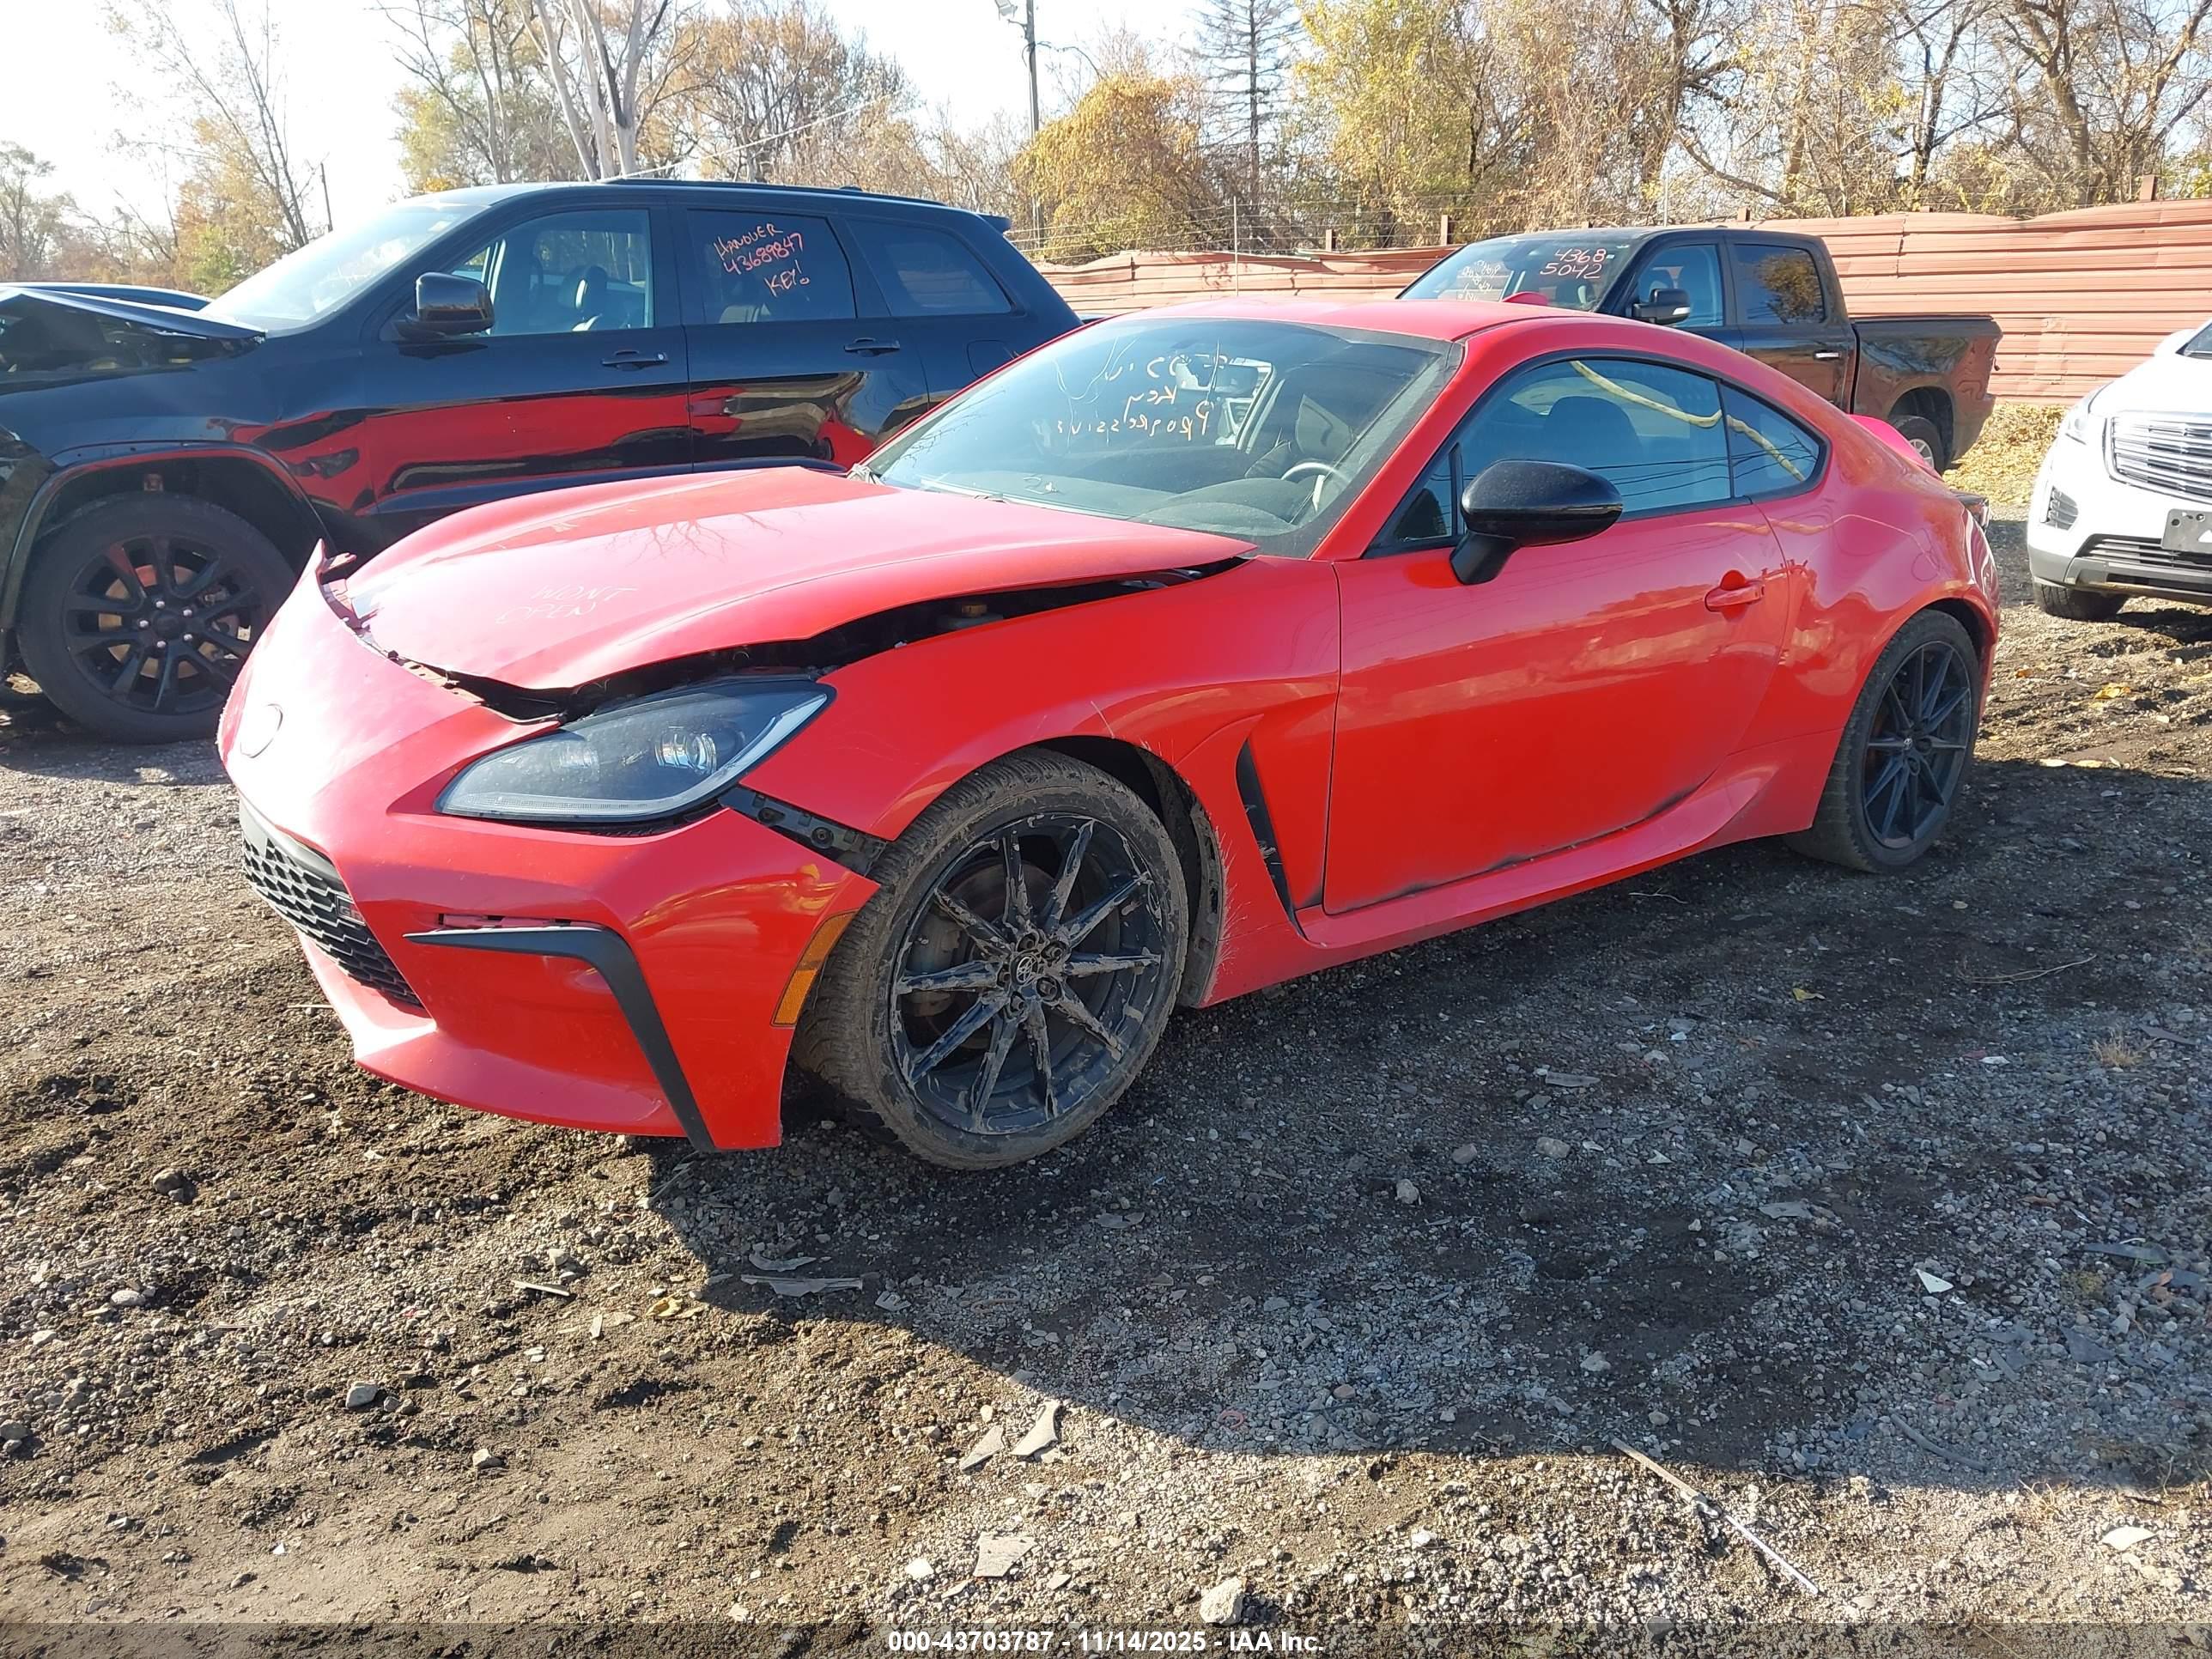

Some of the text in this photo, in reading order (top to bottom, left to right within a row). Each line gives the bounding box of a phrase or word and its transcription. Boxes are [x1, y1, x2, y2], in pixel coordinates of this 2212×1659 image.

[723, 233, 803, 275] 43689847
[1553, 248, 1607, 264] 4368
[1540, 263, 1603, 279] 5042
